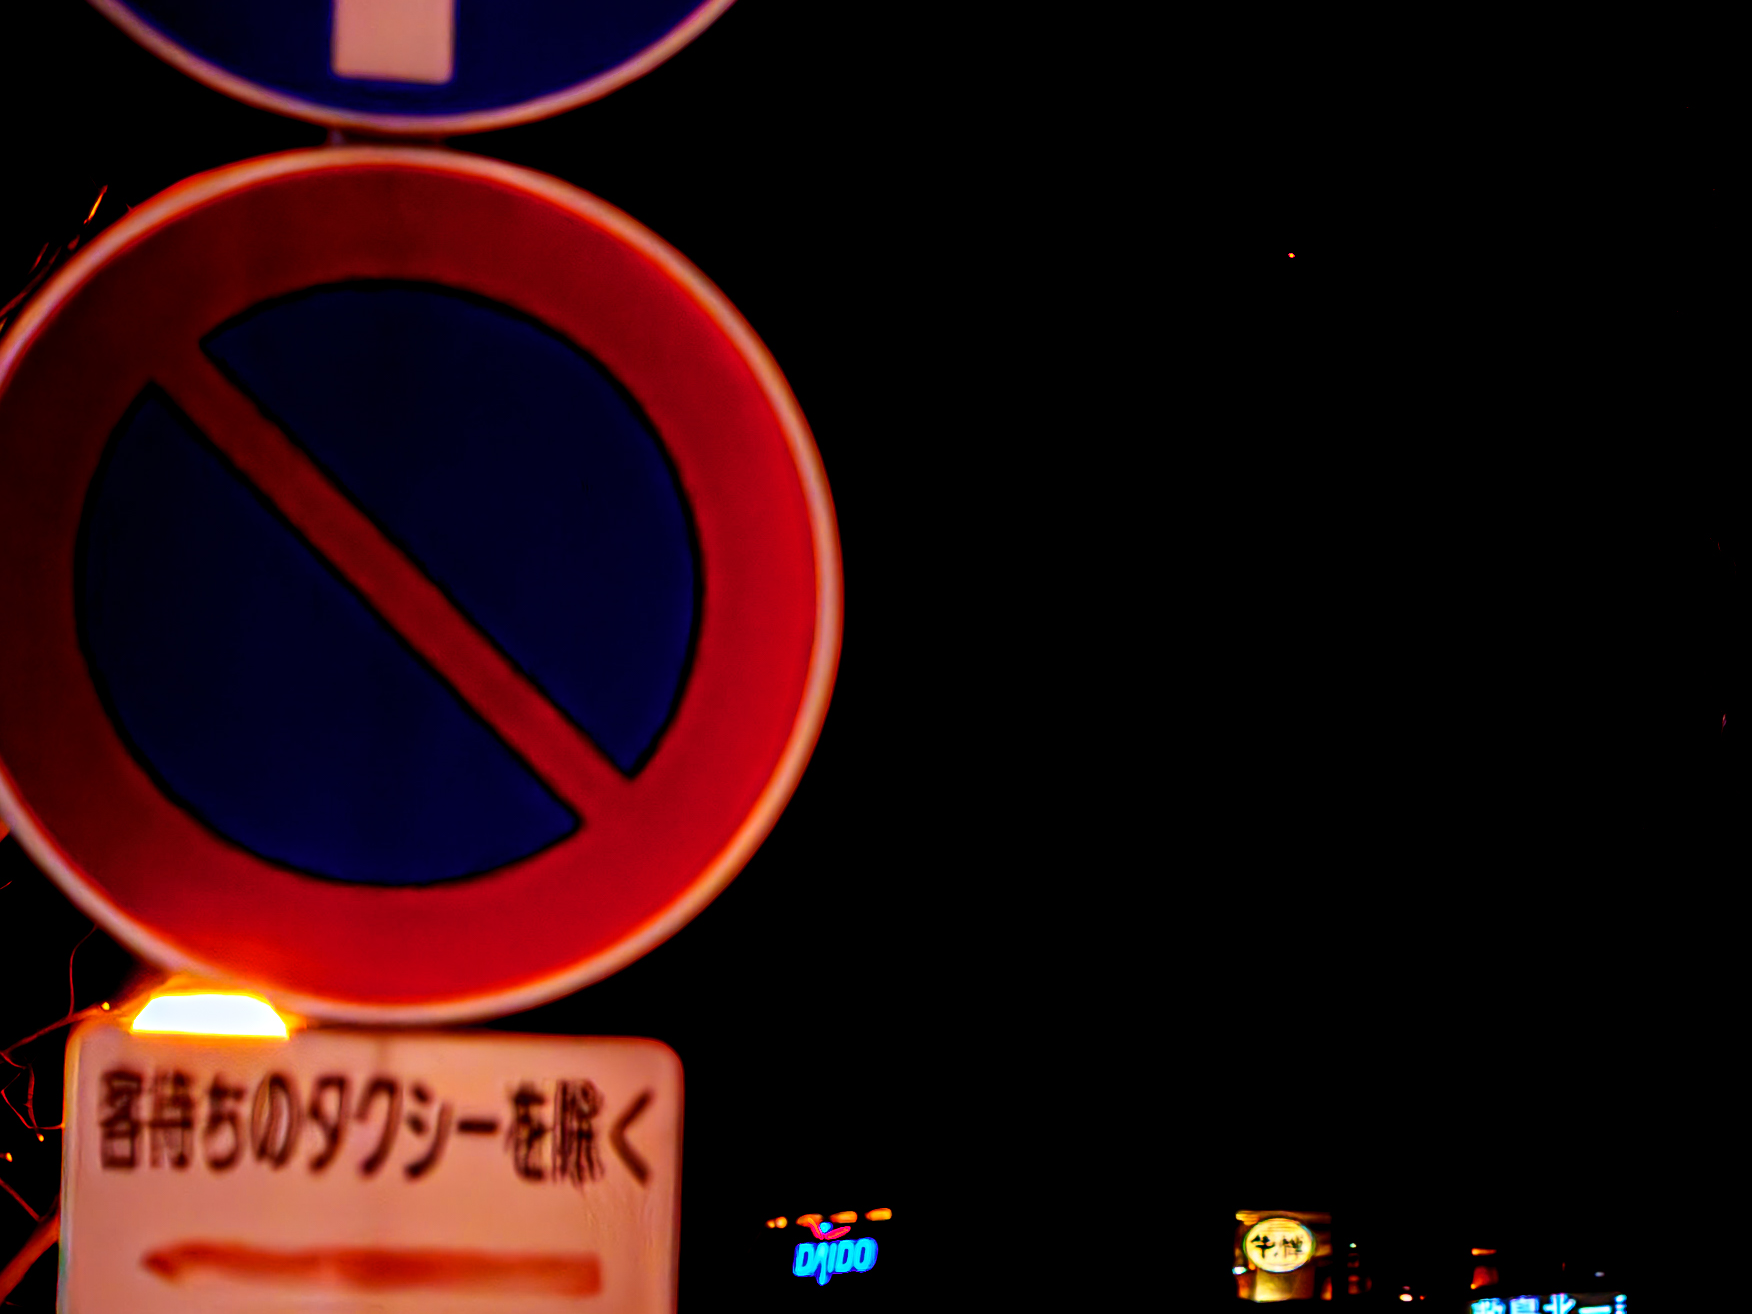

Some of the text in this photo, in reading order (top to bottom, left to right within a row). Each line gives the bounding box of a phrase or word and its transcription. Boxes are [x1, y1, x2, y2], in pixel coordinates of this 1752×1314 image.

[98, 1066, 655, 1187] 客待ちのタクシーを除く
